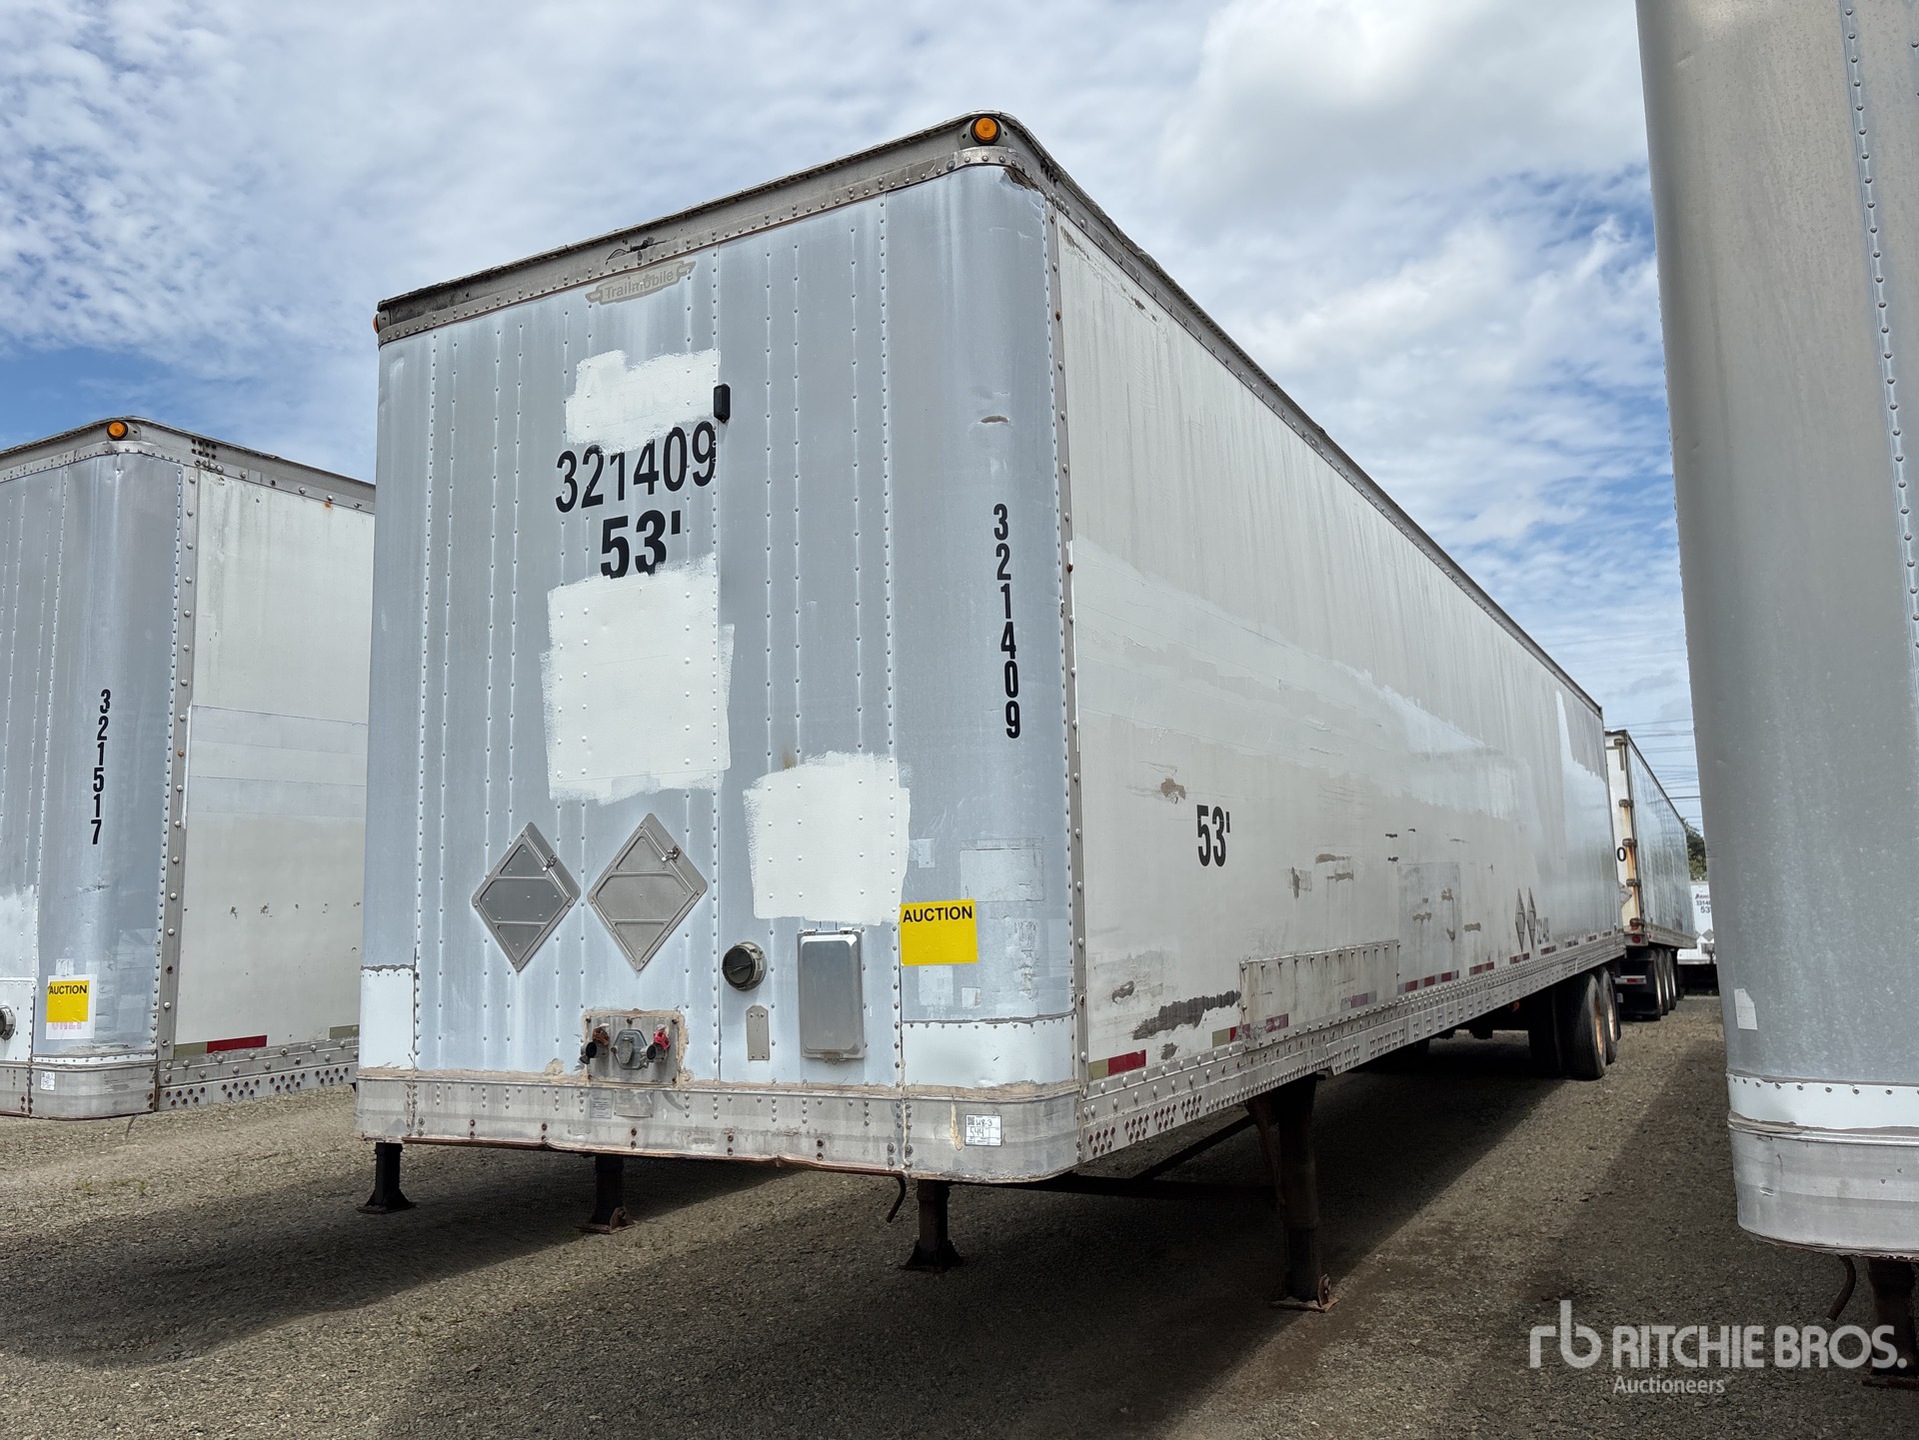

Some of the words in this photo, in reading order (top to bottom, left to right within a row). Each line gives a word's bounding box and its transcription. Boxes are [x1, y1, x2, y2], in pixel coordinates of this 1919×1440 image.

[605, 269, 674, 299] Trailmobile
[555, 421, 716, 513] 321409
[601, 510, 681, 579] 53'
[993, 503, 1021, 739] 321409
[91, 689, 111, 845] 321517
[1196, 804, 1230, 867] 53'
[903, 905, 973, 923] AUCTION
[49, 984, 88, 995] AUCTION
